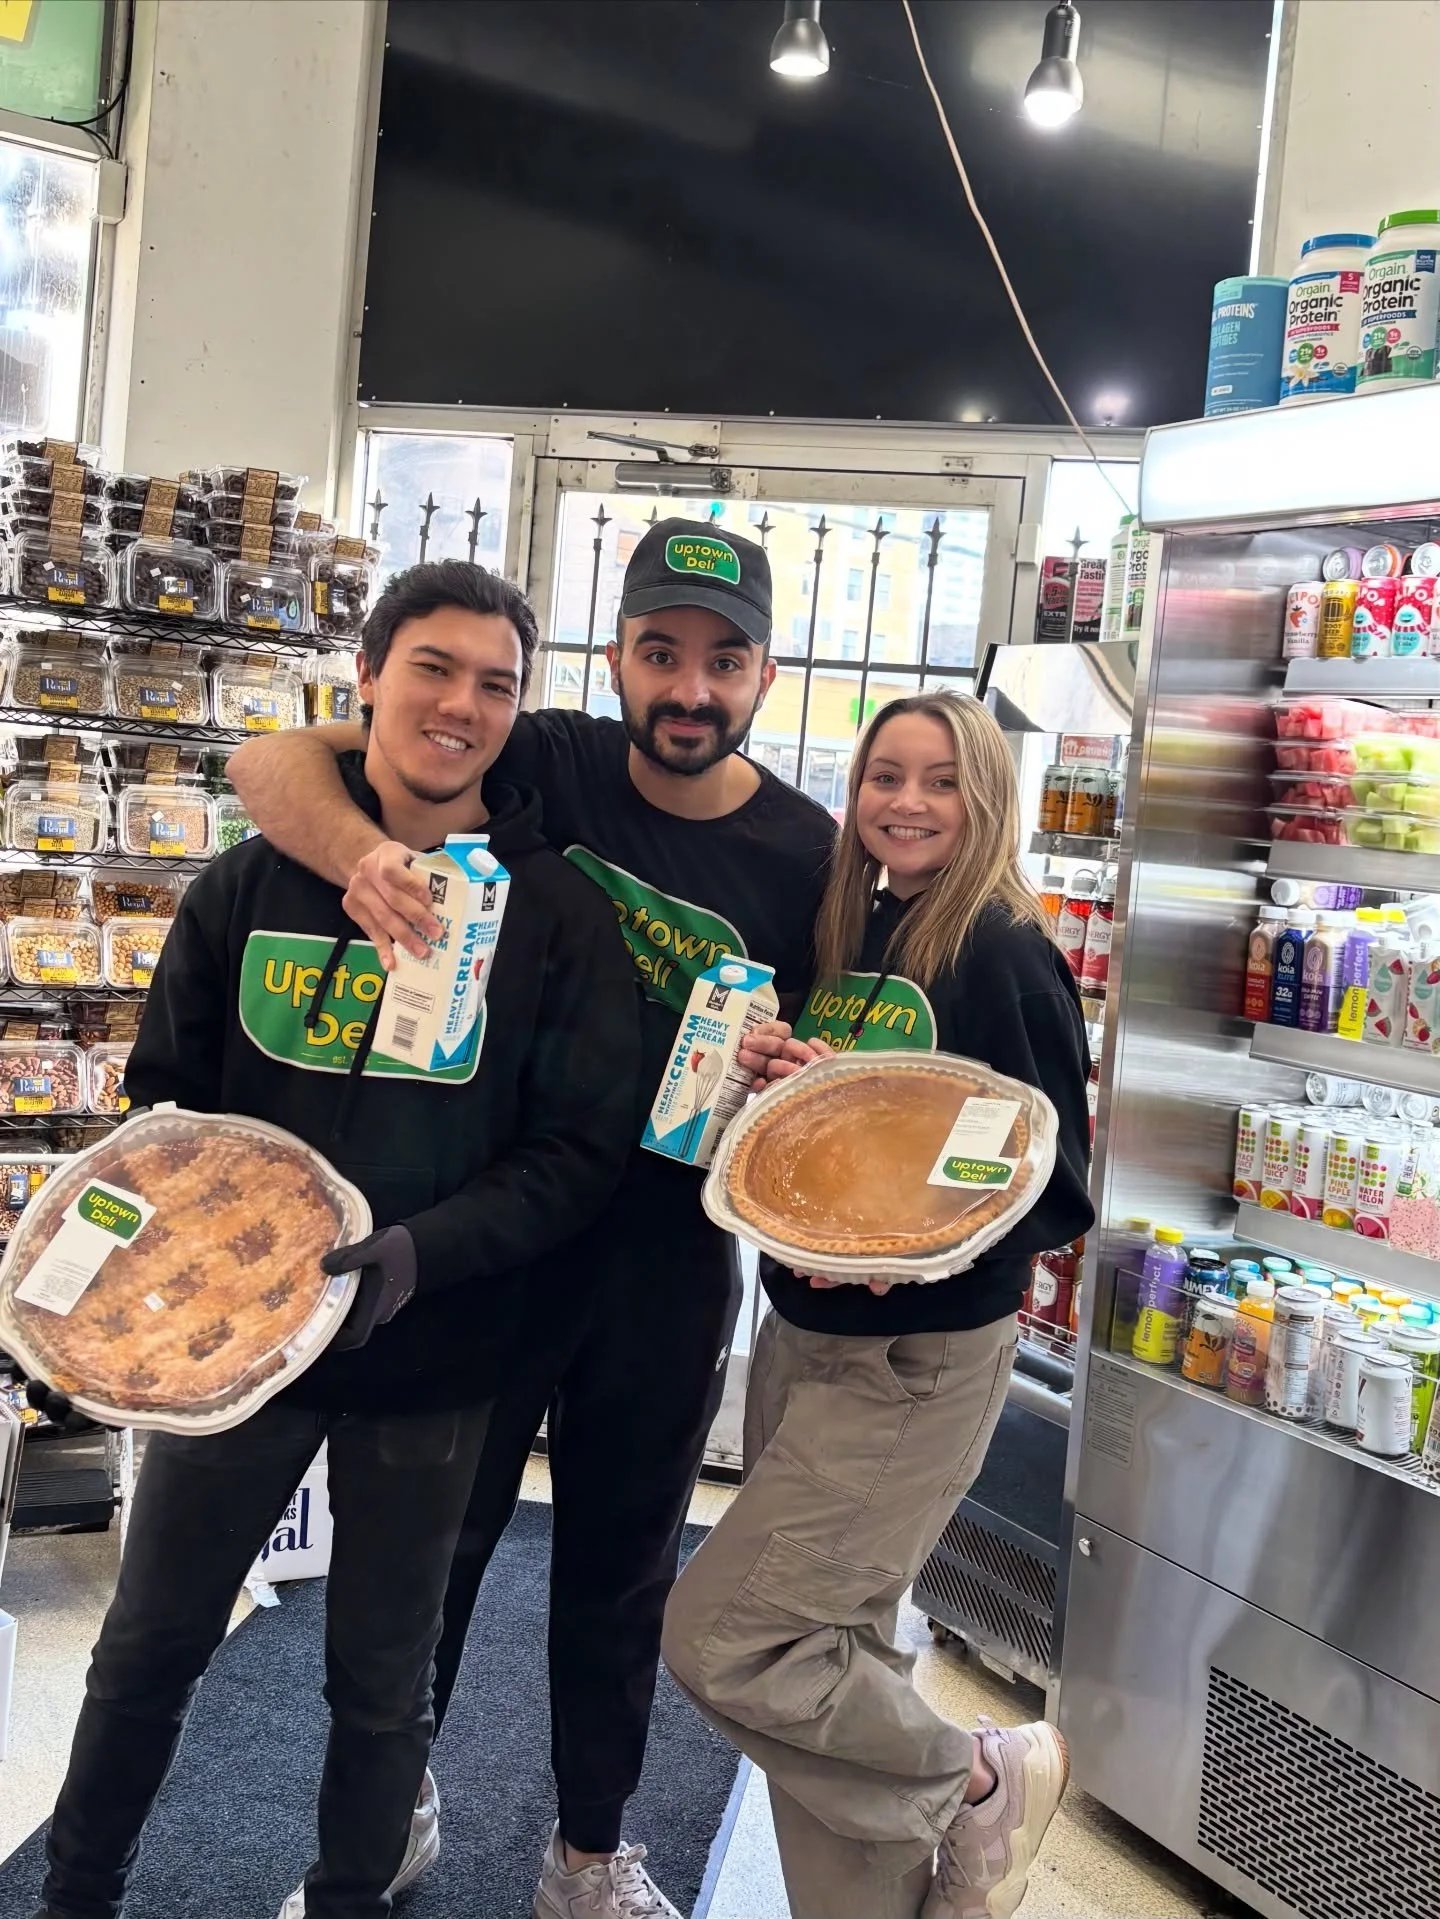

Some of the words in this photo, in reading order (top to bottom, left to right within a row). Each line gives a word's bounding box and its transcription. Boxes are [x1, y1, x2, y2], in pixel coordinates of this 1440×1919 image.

[1369, 263, 1406, 281] Orgain
[1296, 282, 1330, 298] Orgain
[1218, 303, 1255, 319] PROTEINS
[1289, 293, 1343, 314] Organic
[1362, 291, 1414, 316] Protein
[1290, 307, 1338, 328] Protein
[1211, 321, 1240, 335] OLLAGEN
[1210, 333, 1238, 349] EPTIDES
[686, 557, 715, 570] Deli
[1080, 570, 1105, 580] Tasti
[1290, 591, 1319, 607] LIPO
[478, 920, 499, 930] HEAVY
[612, 901, 732, 967] town
[1278, 963, 1295, 975] koia
[1303, 969, 1323, 982] koia
[264, 959, 385, 1008] Upto
[445, 998, 459, 1034] HEAVY
[454, 922, 478, 996] CREAM
[1349, 989, 1359, 1021] lemon
[306, 1011, 368, 1050] De
[698, 1025, 727, 1037] WHIPPING
[700, 1017, 730, 1031] HEAVY
[696, 1030, 725, 1045] CREAM
[658, 1080, 674, 1114] HEAVY
[670, 1014, 702, 1080] CREAM
[664, 1082, 679, 1115] WHIPPING
[1264, 1162, 1289, 1172] MANGO
[960, 1171, 987, 1181] Deli
[1330, 1178, 1348, 1189] PINE
[1328, 1186, 1351, 1197] APPLE
[1358, 1194, 1384, 1205] MELON
[1359, 1186, 1384, 1197] WATER
[90, 1209, 119, 1227] Deli
[1142, 1309, 1154, 1343] lemon
